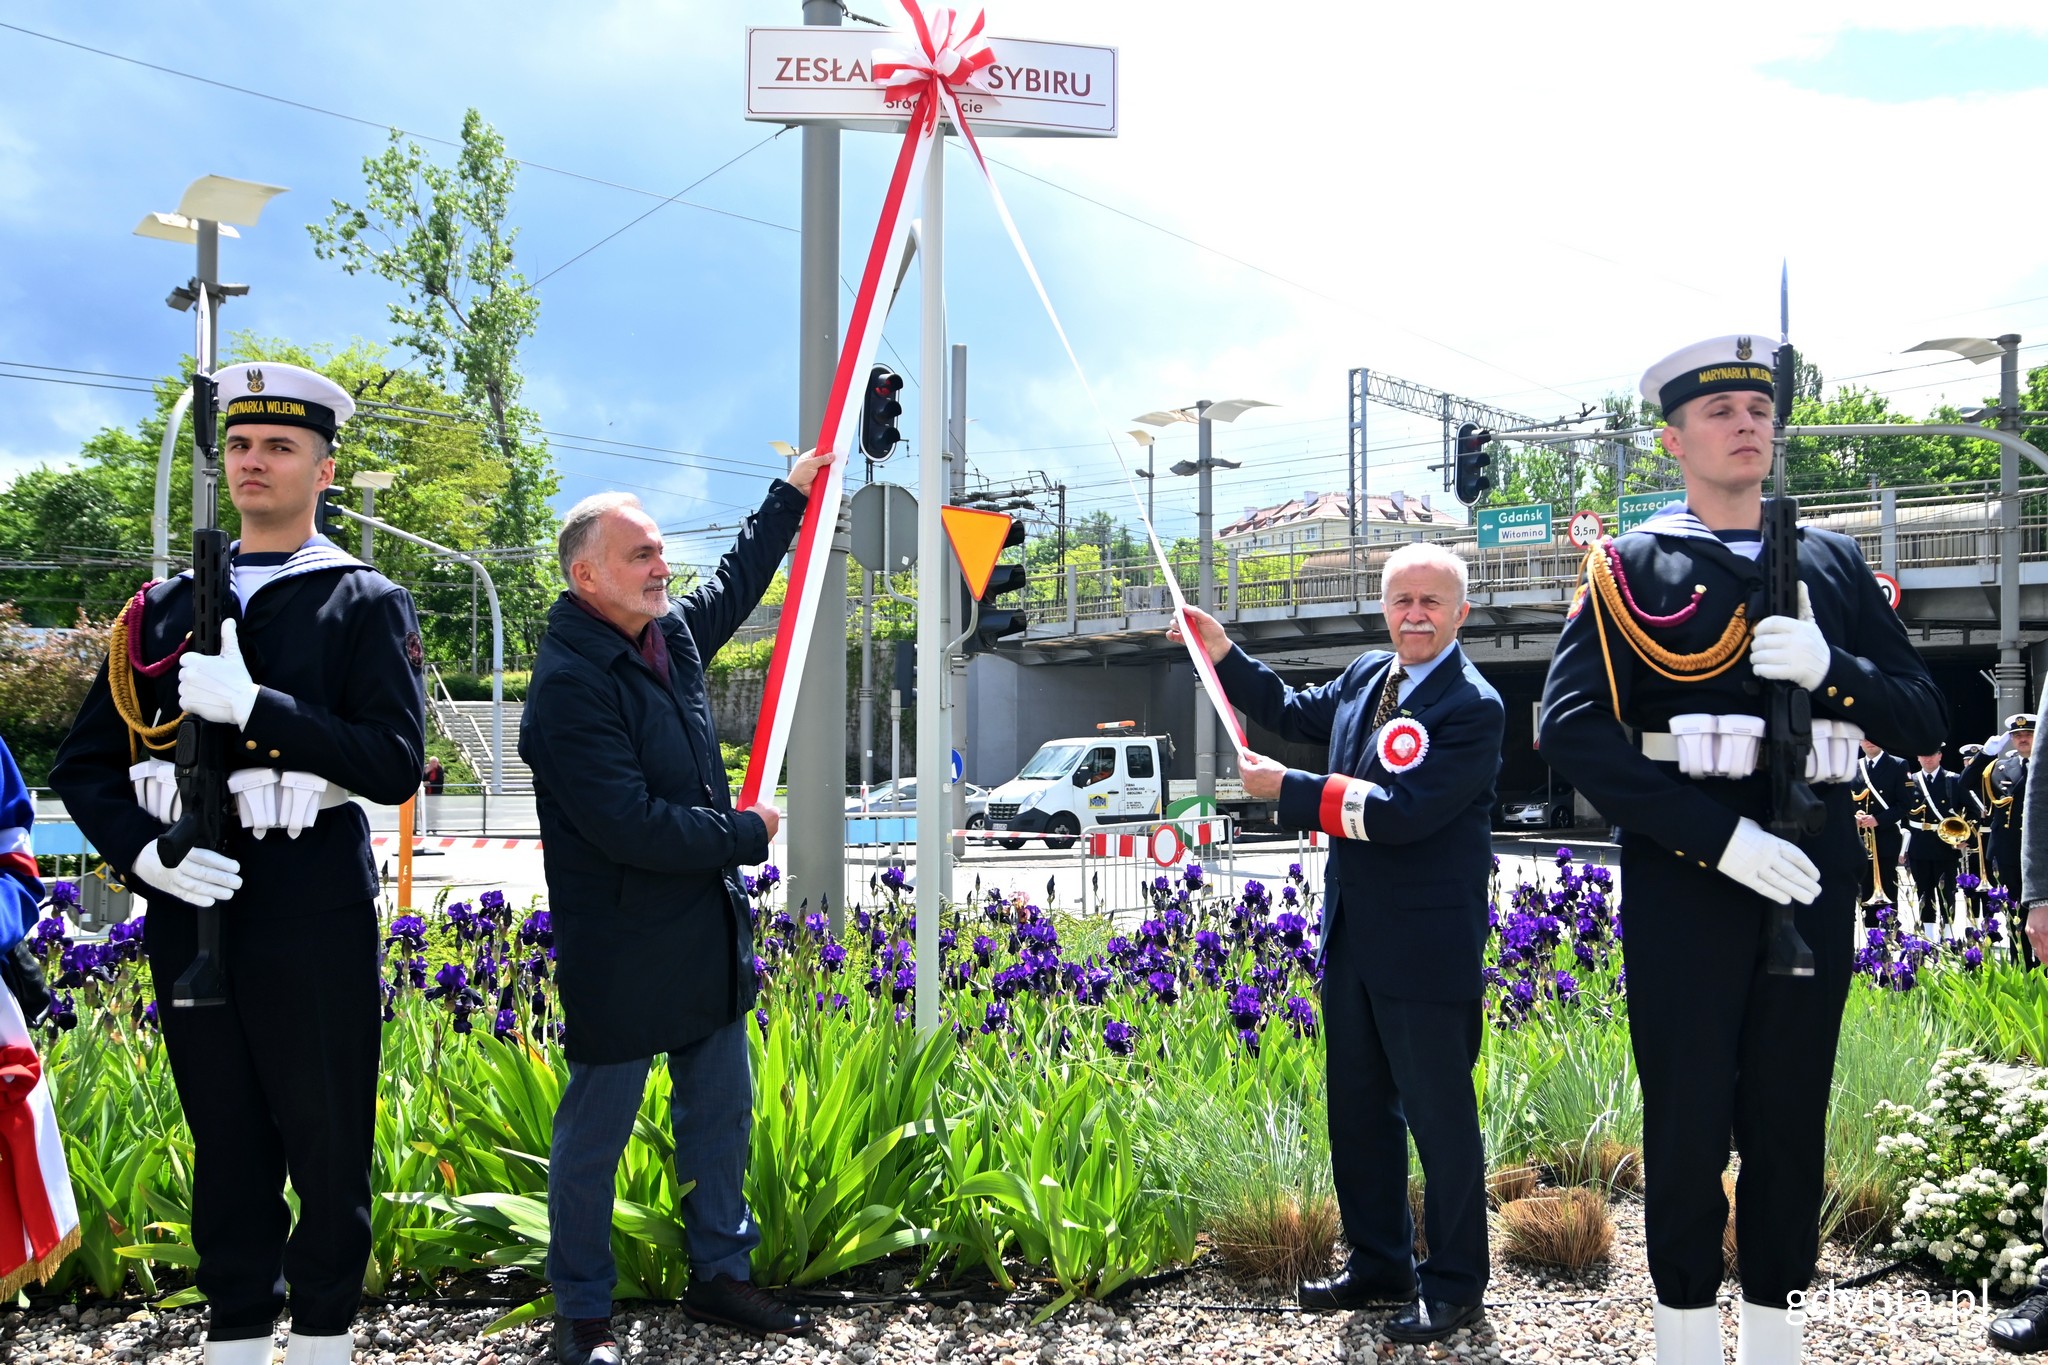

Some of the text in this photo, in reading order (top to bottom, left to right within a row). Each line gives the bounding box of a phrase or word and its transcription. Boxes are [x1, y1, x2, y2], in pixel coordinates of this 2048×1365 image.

[988, 65, 1091, 97] SYBIRU
[1699, 367, 1747, 383] MARYNARKA
[267, 400, 306, 416] WOJENNA
[1498, 509, 1543, 524] Gdańsk
[1501, 529, 1543, 539] Witomino
